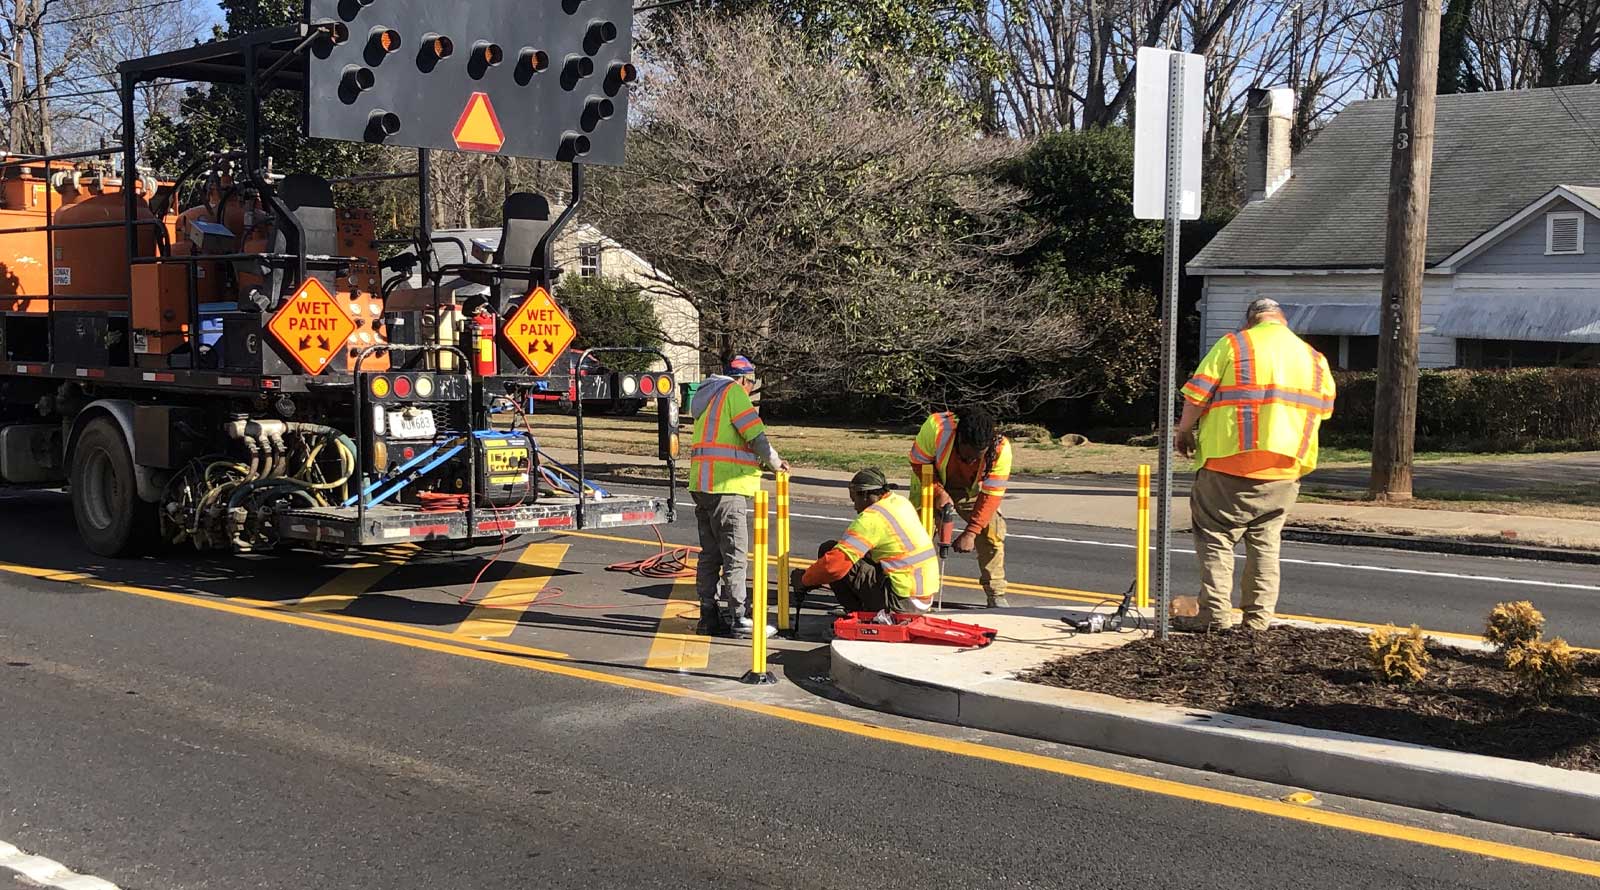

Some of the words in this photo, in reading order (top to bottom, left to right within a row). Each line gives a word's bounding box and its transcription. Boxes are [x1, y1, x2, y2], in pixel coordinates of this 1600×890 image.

[1397, 89, 1409, 150] 113
[297, 301, 330, 315] WET
[526, 309, 555, 321] WET
[289, 317, 338, 331] PAINT
[520, 323, 561, 336] PAINT
